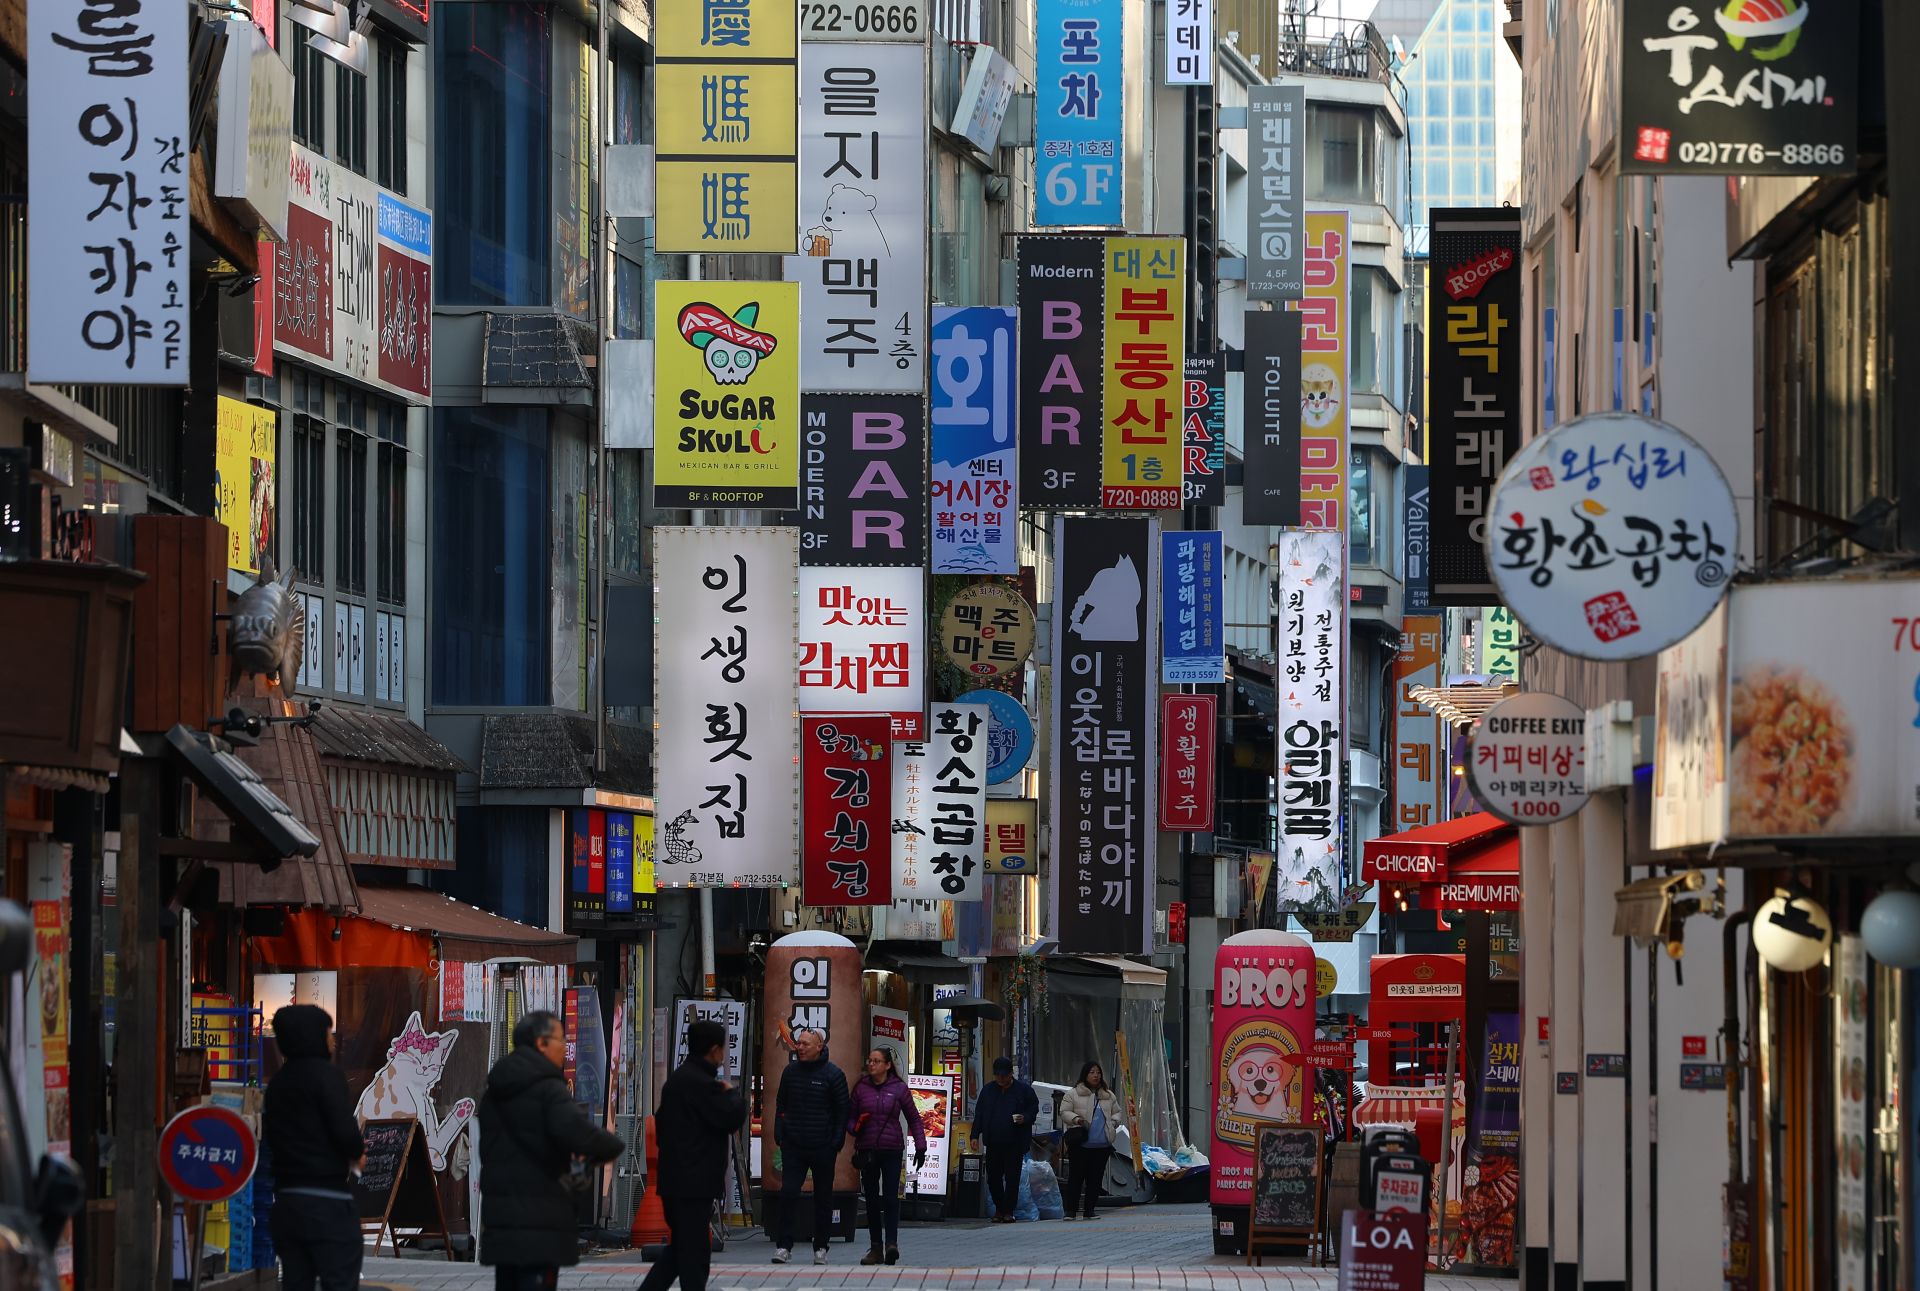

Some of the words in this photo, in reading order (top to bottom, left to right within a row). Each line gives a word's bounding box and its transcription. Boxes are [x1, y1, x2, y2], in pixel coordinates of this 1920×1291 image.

[801, 4, 918, 34] 722-0666
[1059, 20, 1100, 118] 포차
[820, 67, 880, 180] 을지
[1044, 141, 1072, 158] 종각
[1079, 141, 1114, 157] 1호점
[1678, 142, 1844, 165] 02)776-8866
[1045, 162, 1113, 207] 6F
[1260, 118, 1292, 228] 레지던스
[78, 97, 153, 369] 이자카야
[1265, 235, 1288, 258] Q
[1030, 264, 1094, 280] Modern
[1113, 248, 1176, 280] 대신
[1448, 257, 1503, 295] ROCK
[822, 258, 880, 369] 맥주
[163, 320, 181, 370] 2F
[888, 311, 918, 370] 4층
[1039, 301, 1084, 446] BAR
[1111, 288, 1174, 445] 부동산
[932, 324, 1009, 443] 회
[1264, 356, 1281, 447] FOLUITE
[1184, 379, 1214, 475] BAR
[679, 462, 719, 470] MEXICAN
[723, 462, 741, 470] BAR
[754, 462, 779, 470] GRILL
[807, 411, 827, 520] MODERN
[968, 458, 1003, 478] 센터
[1043, 468, 1076, 490] 3F
[1120, 453, 1164, 482] 1층
[1561, 442, 1687, 491] 왕십리
[848, 412, 909, 549] BAR
[1183, 481, 1206, 500] 3F
[1264, 488, 1281, 497] CAFE
[712, 492, 764, 501] ROOFTOP
[931, 480, 1012, 511] 어시장
[1106, 489, 1178, 507] 720-0889
[936, 511, 1002, 528] 활어회
[802, 532, 829, 549] 3F
[936, 527, 1002, 544] 해산물
[818, 586, 909, 626] 맛있는
[955, 606, 1020, 634] 맥주
[953, 636, 1018, 662] 마트
[1287, 589, 1306, 683] 원기보양
[799, 642, 910, 694] 김치찜
[1312, 609, 1334, 703] 전통주점
[1169, 671, 1180, 679] 02
[1182, 671, 1197, 679] 733
[1198, 671, 1218, 679] 5597
[698, 555, 753, 839] 인생횟집
[1069, 651, 1103, 763] 이웃집
[1489, 717, 1547, 734] COFFEE
[1552, 718, 1585, 735] EXIT
[1174, 705, 1200, 820] 생활맥주
[930, 709, 983, 894] 황소곱창
[1490, 781, 1585, 797] 아메리카노
[1102, 730, 1136, 915] 로바다야끼
[1006, 858, 1021, 868] 5F
[689, 872, 725, 884] 종각본점
[1441, 883, 1503, 902] PREMIUM
[1315, 929, 1350, 939] やきとり
[1233, 957, 1259, 967] THE
[1221, 967, 1307, 1008] BROS
[1390, 984, 1415, 996] 이웃집
[1417, 984, 1460, 996] 로바다야끼
[1372, 1030, 1392, 1038] BROS
[1306, 1057, 1333, 1066] 인생횟집
[1487, 1043, 1520, 1065] 살치
[1220, 1118, 1240, 1133] THE
[178, 1143, 237, 1164] 주차금지
[1221, 1166, 1241, 1176] BROS
[1380, 1177, 1419, 1194] 주차금지
[1351, 1225, 1414, 1250] LOA
